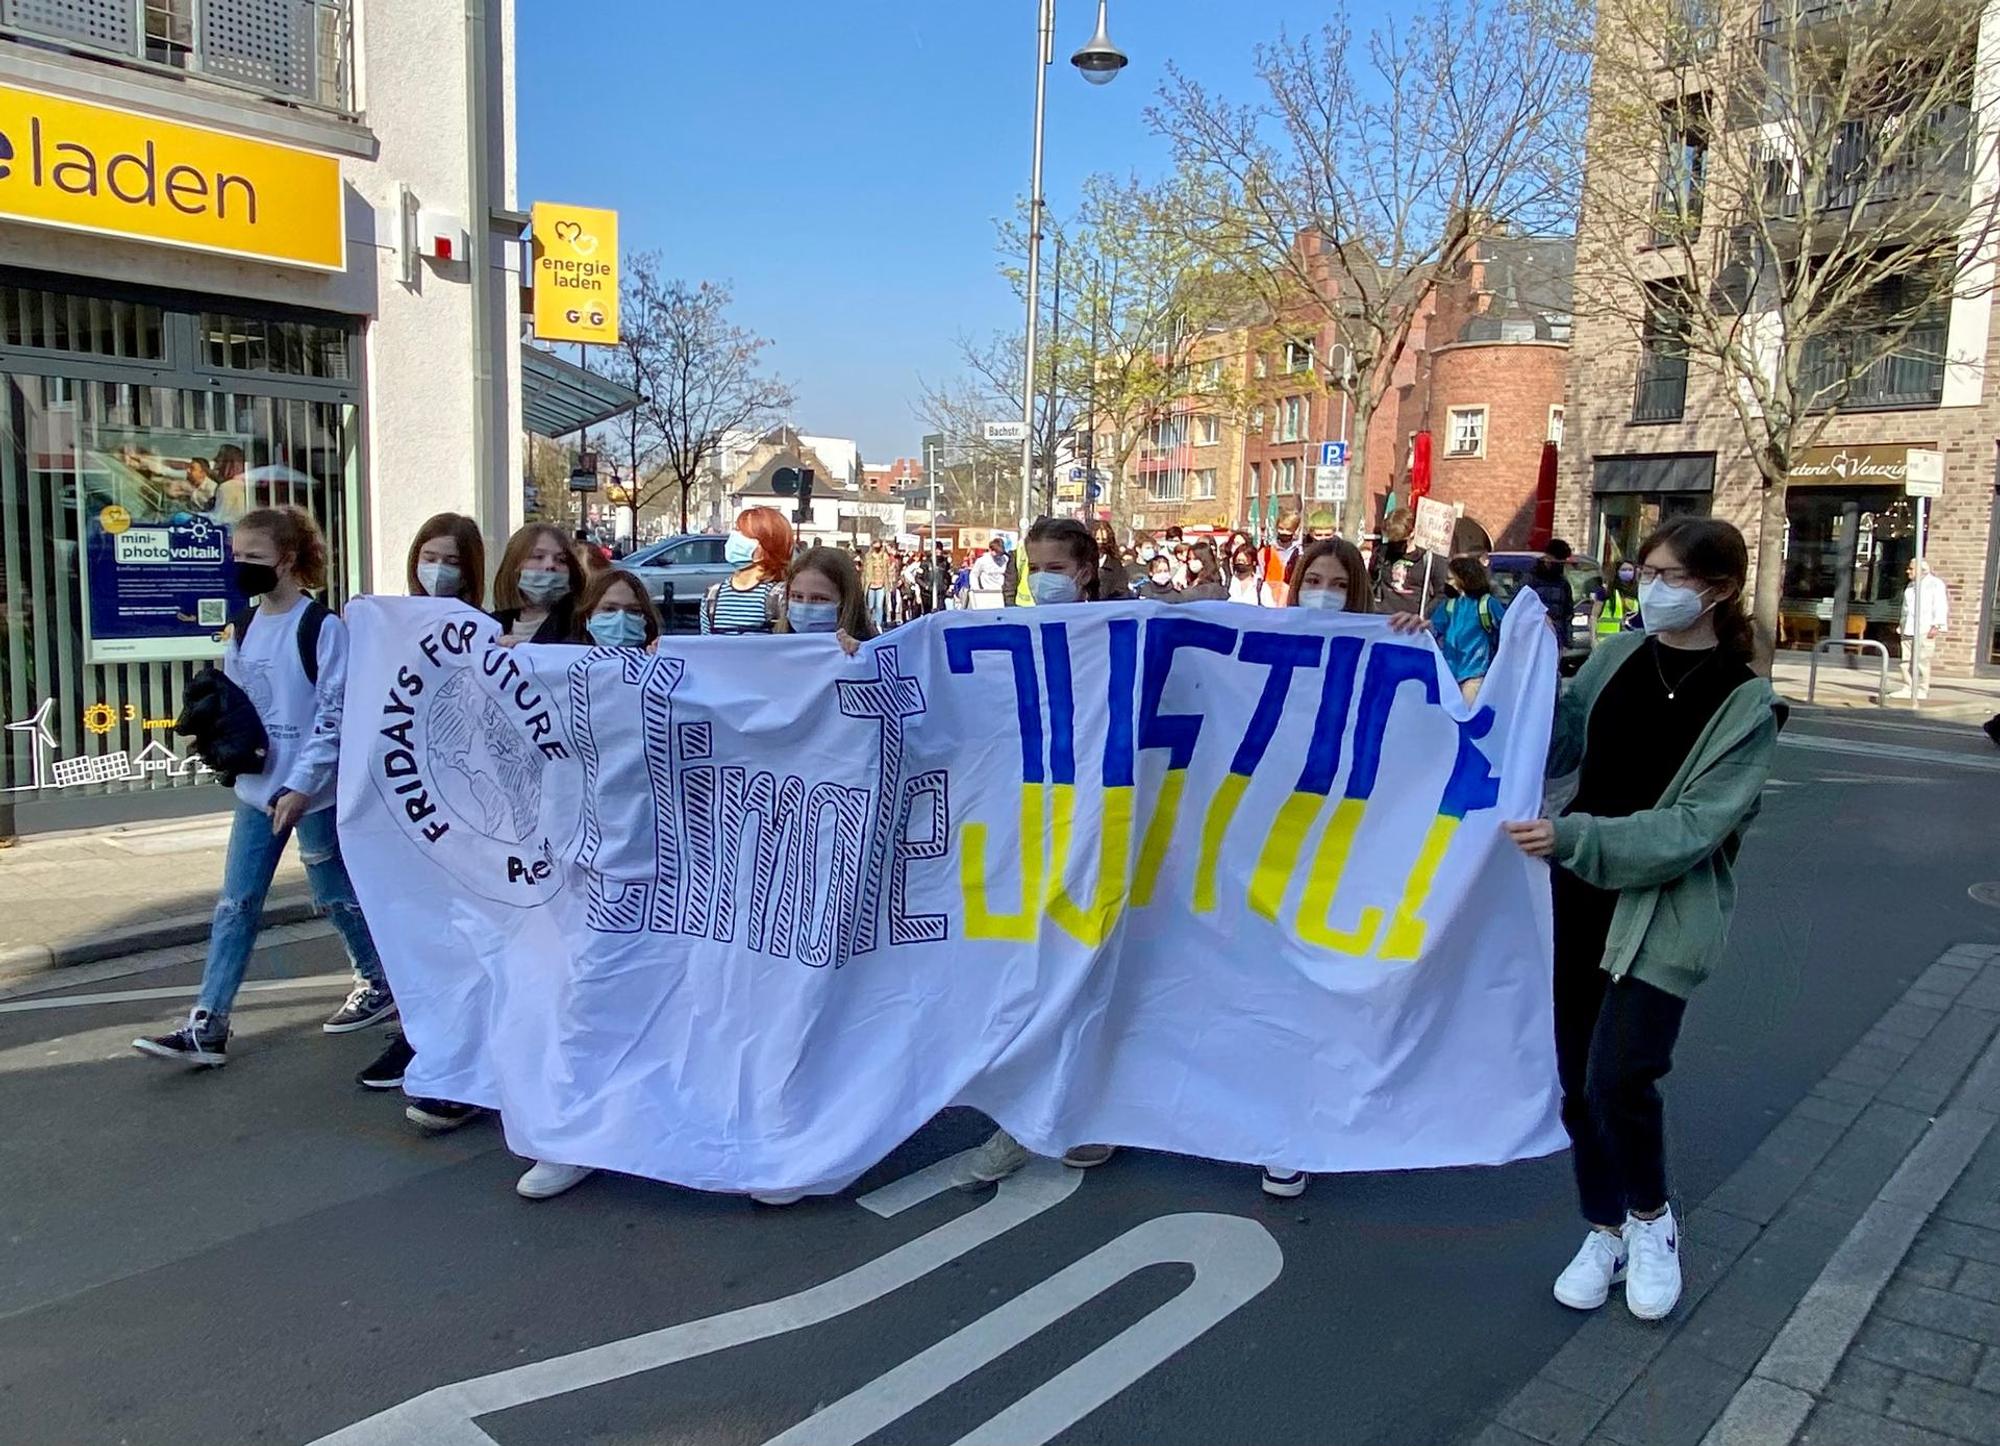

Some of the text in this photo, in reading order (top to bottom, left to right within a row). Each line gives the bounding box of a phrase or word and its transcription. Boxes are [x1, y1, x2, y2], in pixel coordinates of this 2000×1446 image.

[542, 258, 611, 276] energie
[553, 271, 602, 290] laden
[1850, 455, 1907, 480] Venezia
[121, 533, 156, 544] mini-
[122, 545, 220, 559] photovoltaik
[380, 620, 570, 843] FRIDAYS FOR UTURE
[568, 644, 948, 969] Climate
